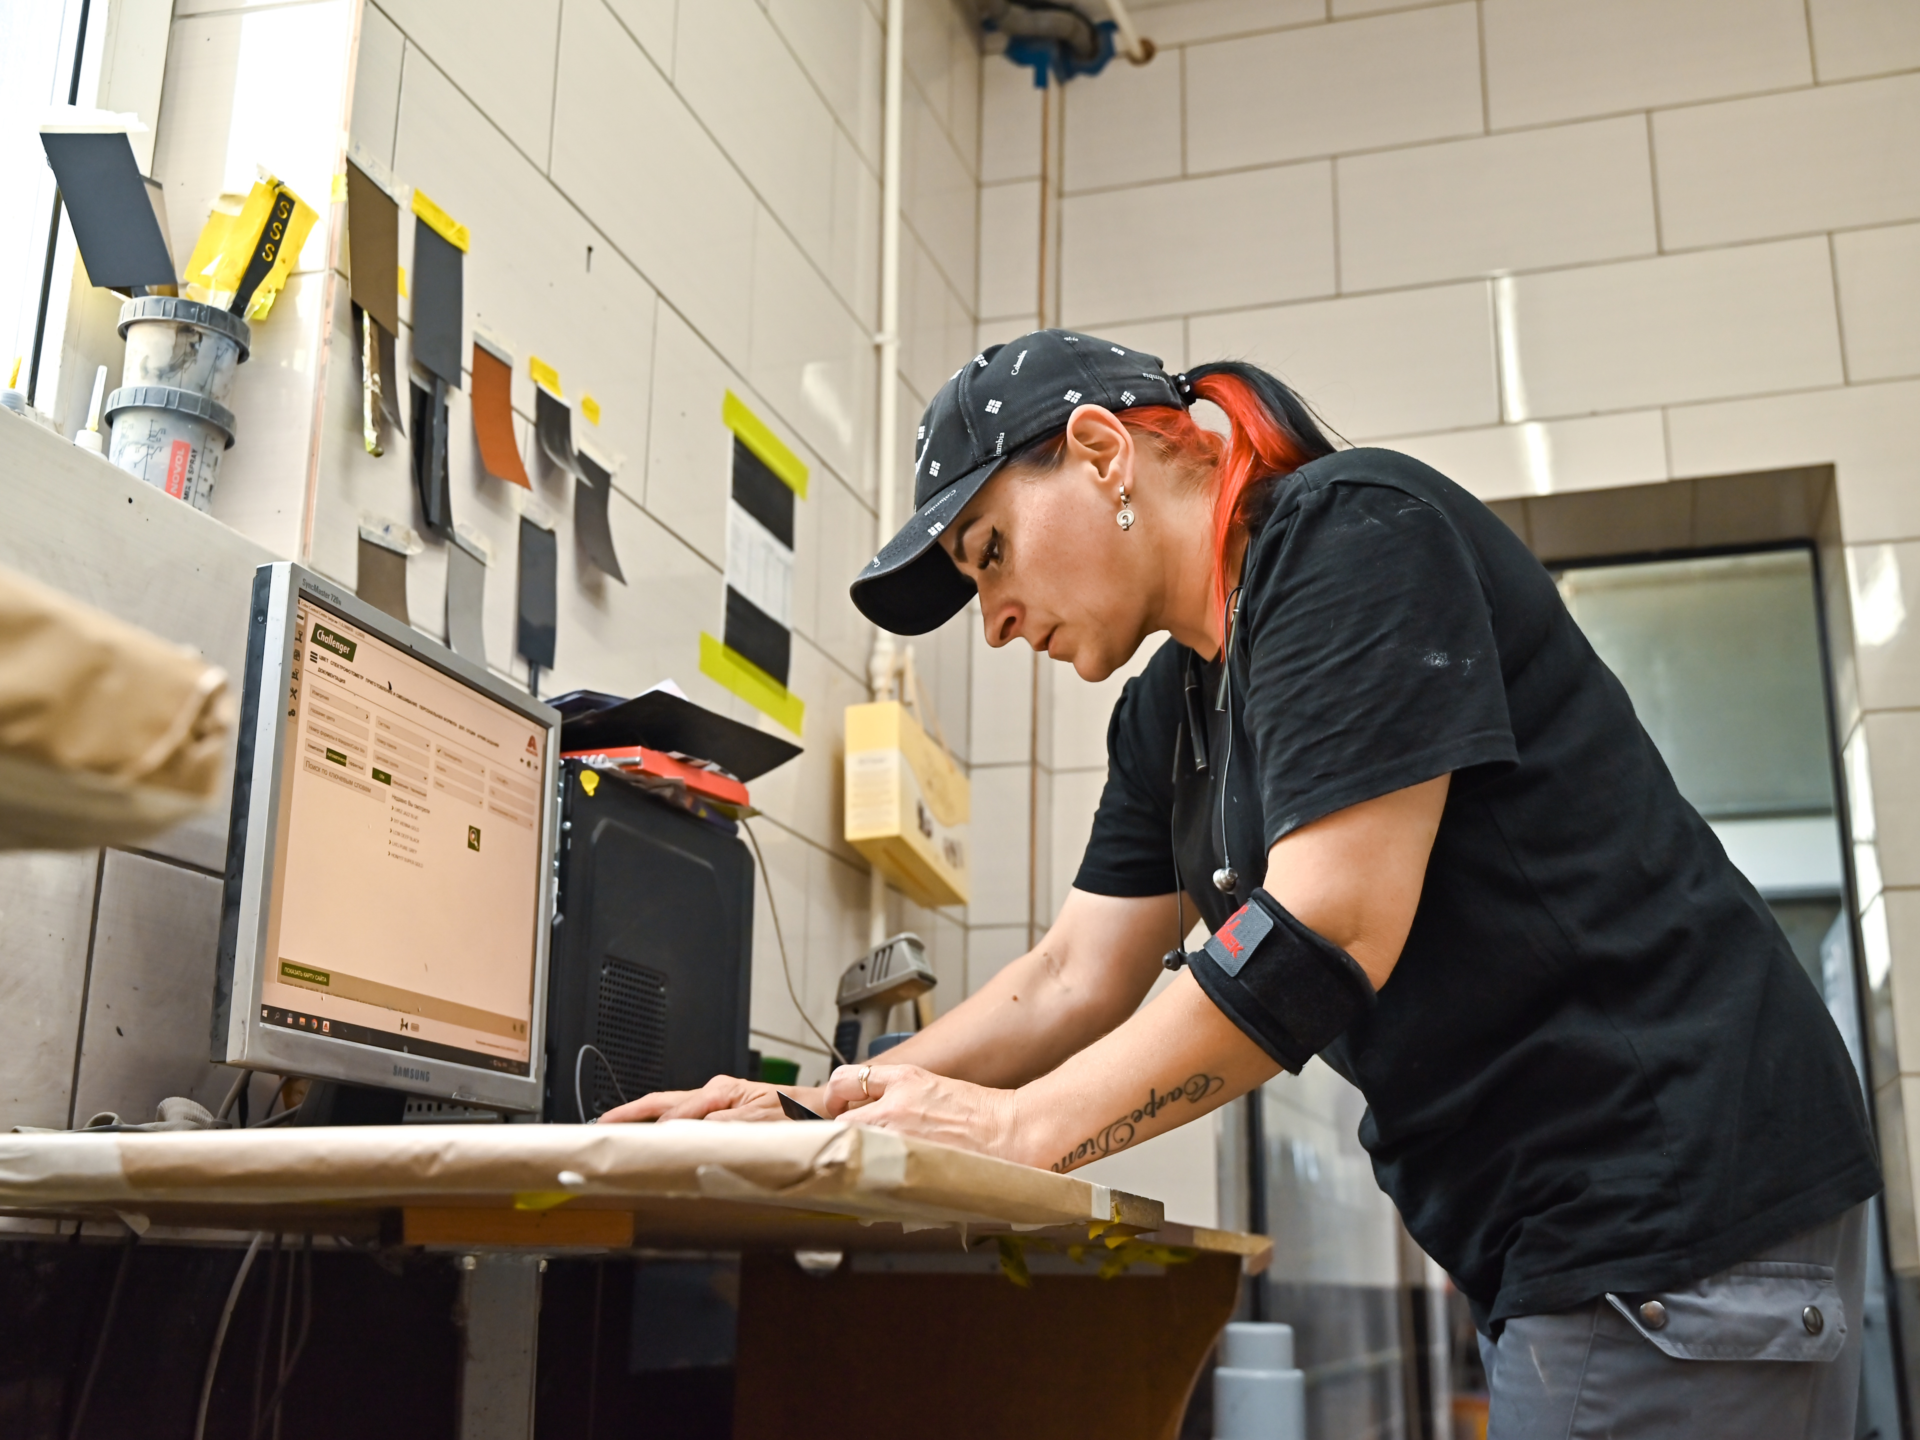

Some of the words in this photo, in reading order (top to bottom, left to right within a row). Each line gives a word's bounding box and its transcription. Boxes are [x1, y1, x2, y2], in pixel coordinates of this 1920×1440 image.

[1011, 349, 1028, 376] Columbia
[170, 447, 186, 495] NOVOL
[188, 448, 198, 475] SPRAY
[924, 489, 957, 517] Columbia
[302, 579, 331, 599] SyncMaster
[316, 629, 351, 655] Challenger
[305, 759, 320, 773] Поиск
[392, 1064, 431, 1083] SAMSUNG
[1131, 1073, 1225, 1124] Carpe
[1050, 1115, 1135, 1174] Diem
